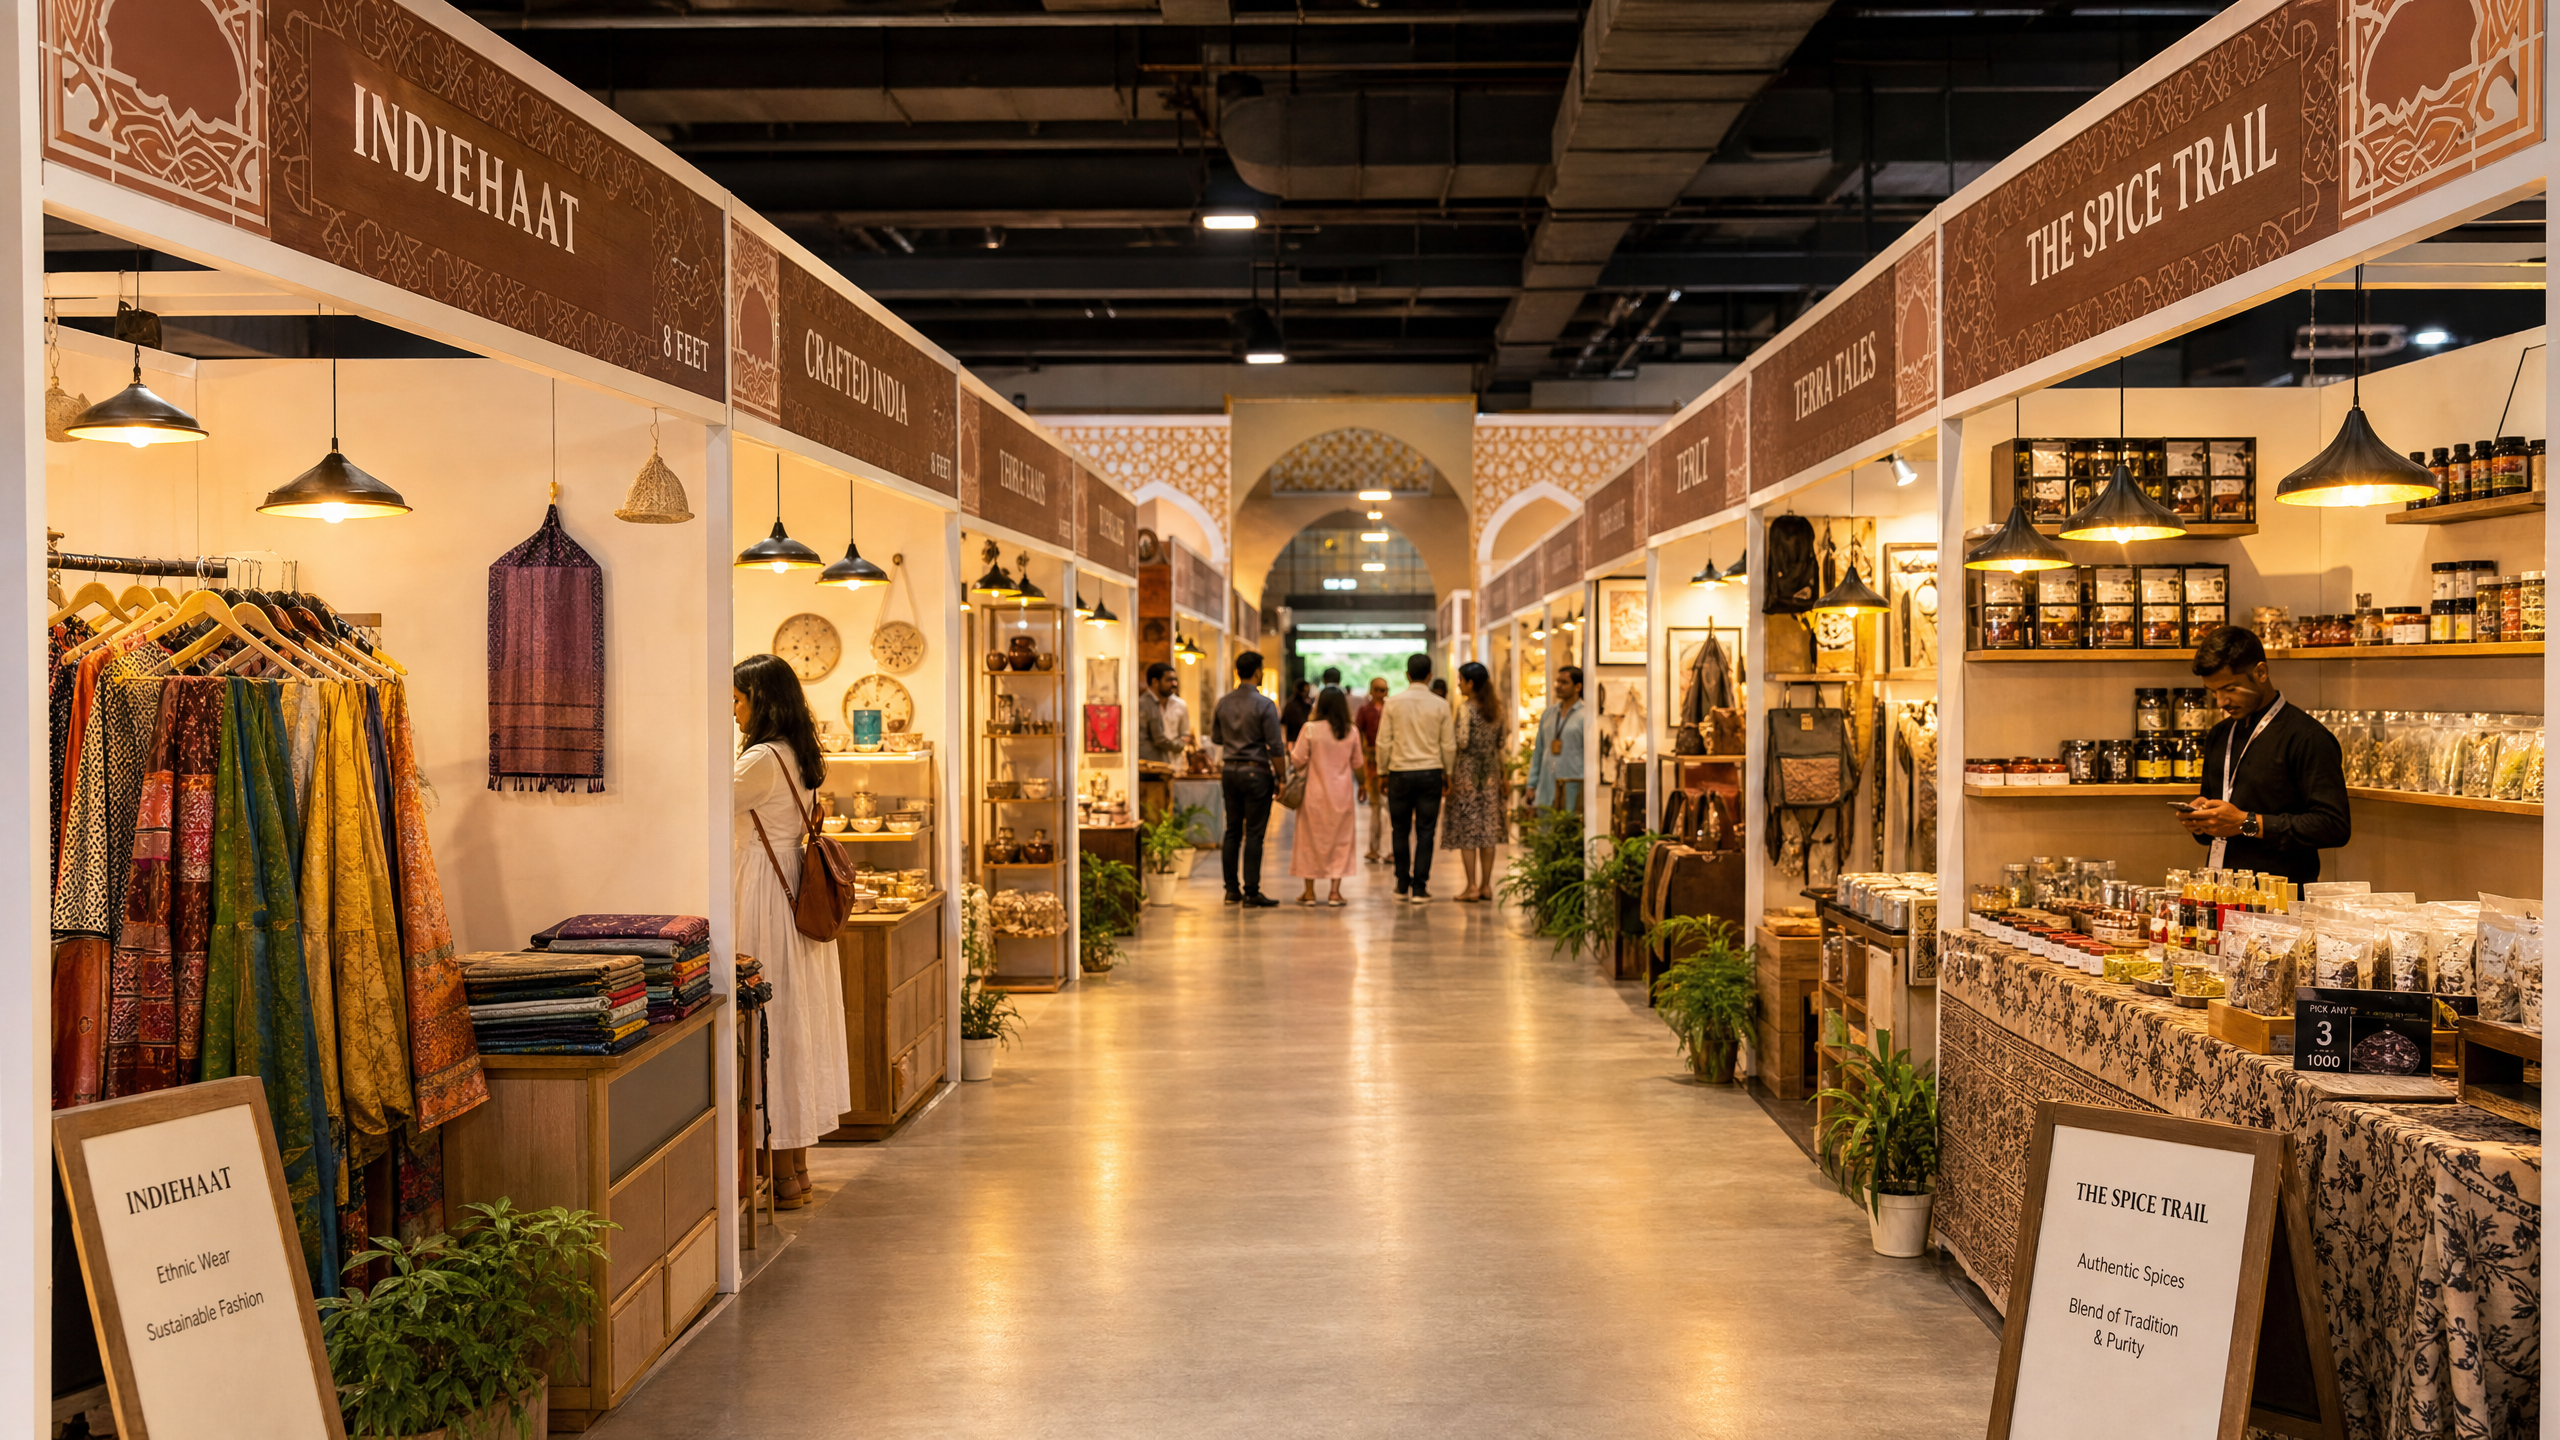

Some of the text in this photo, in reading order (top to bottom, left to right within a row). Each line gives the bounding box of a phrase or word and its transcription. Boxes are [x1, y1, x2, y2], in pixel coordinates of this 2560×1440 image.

[353, 82, 579, 255] INDIEHAAT
[2026, 104, 2278, 287] THE SPICE TRAIL
[663, 324, 710, 373] 8 FEET
[805, 328, 909, 427] CRAFTED INDIA
[1793, 330, 1876, 422] TERRA TALES
[936, 453, 952, 481] FEET
[2309, 1004, 2329, 1014] PICK
[2330, 1005, 2349, 1015] ANY
[2316, 1020, 2333, 1046] 3
[2307, 1053, 2341, 1068] 1000
[125, 1166, 231, 1215] INDIEHAAT
[2076, 1182, 2209, 1224] THE SPICE TRAIL
[156, 1250, 231, 1284] Ethnic Wear
[2076, 1252, 2185, 1289] Authentic Spices
[146, 1291, 265, 1342] Sustainable Fashion
[2069, 1297, 2179, 1337] Blend of Tradition
[2093, 1329, 2145, 1359] & Purity
